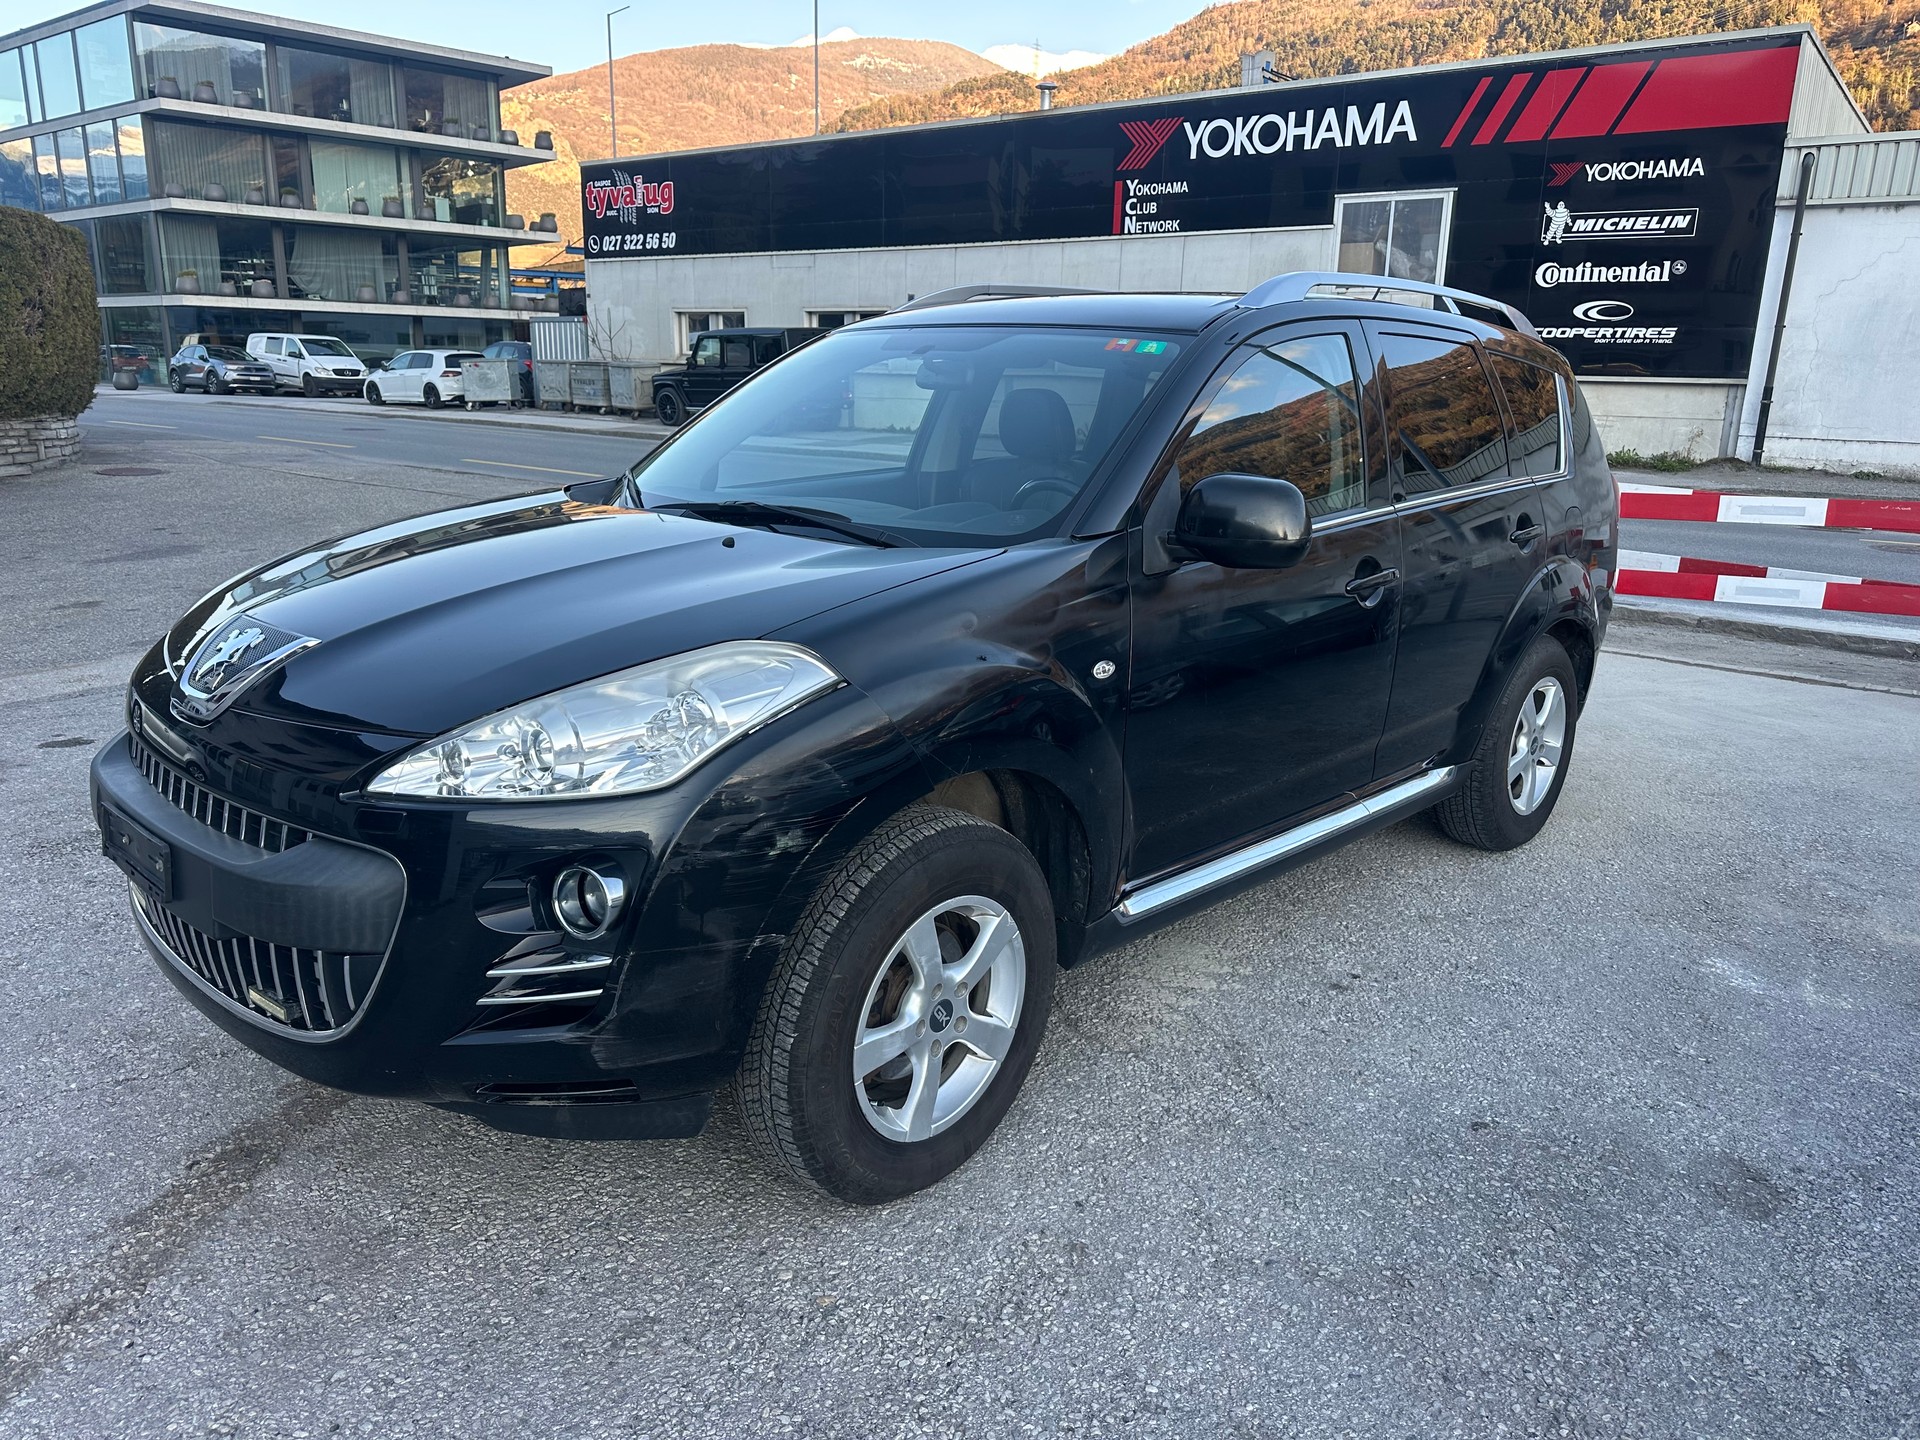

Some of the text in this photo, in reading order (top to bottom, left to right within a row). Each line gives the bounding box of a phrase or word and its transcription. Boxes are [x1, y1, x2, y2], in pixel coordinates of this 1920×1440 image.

[1183, 99, 1418, 160] YOKOHAMA
[1584, 157, 1705, 182] YOKOHAMA
[1571, 214, 1692, 232] MICHELIN
[602, 232, 676, 251] 027 322 56 50
[1535, 260, 1671, 288] Continental
